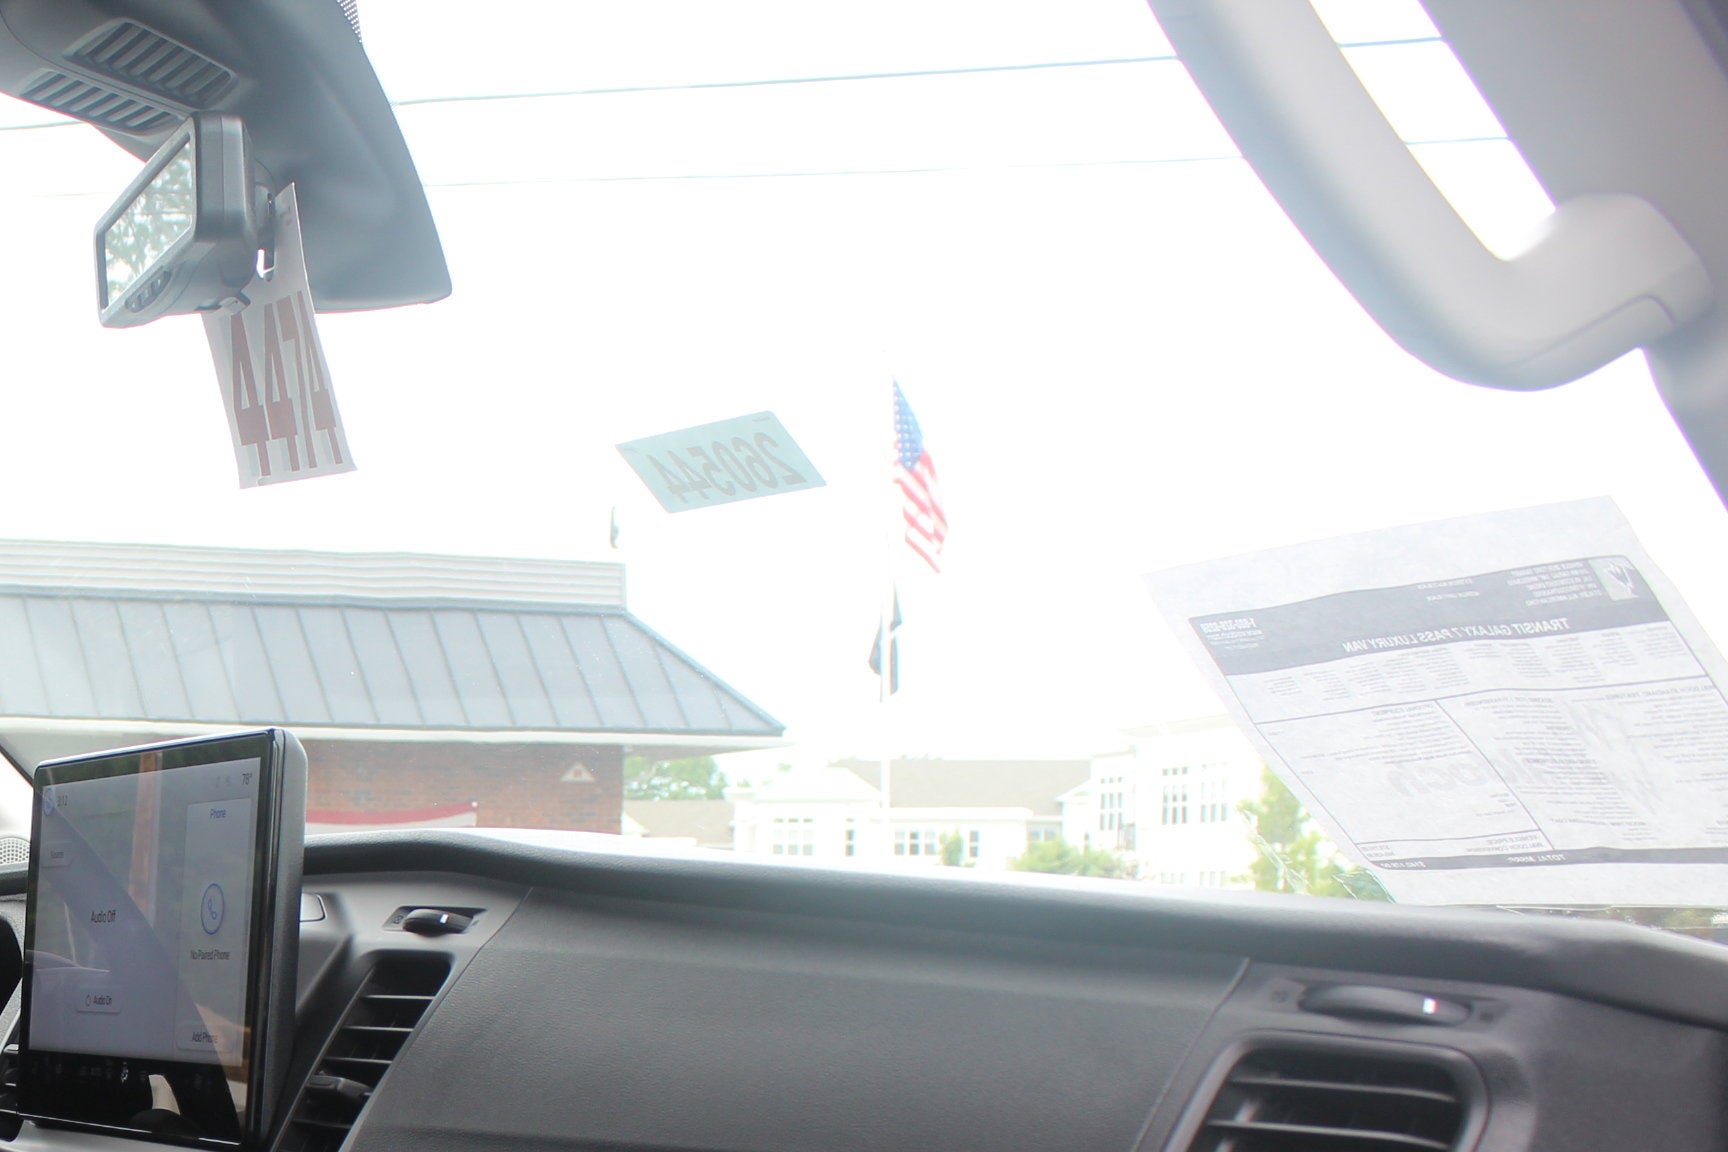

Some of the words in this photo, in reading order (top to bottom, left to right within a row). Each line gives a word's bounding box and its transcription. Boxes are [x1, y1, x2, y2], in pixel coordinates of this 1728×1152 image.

[209, 808, 227, 819] Phone
[90, 911, 107, 923] Audio
[214, 950, 230, 961] Phone
